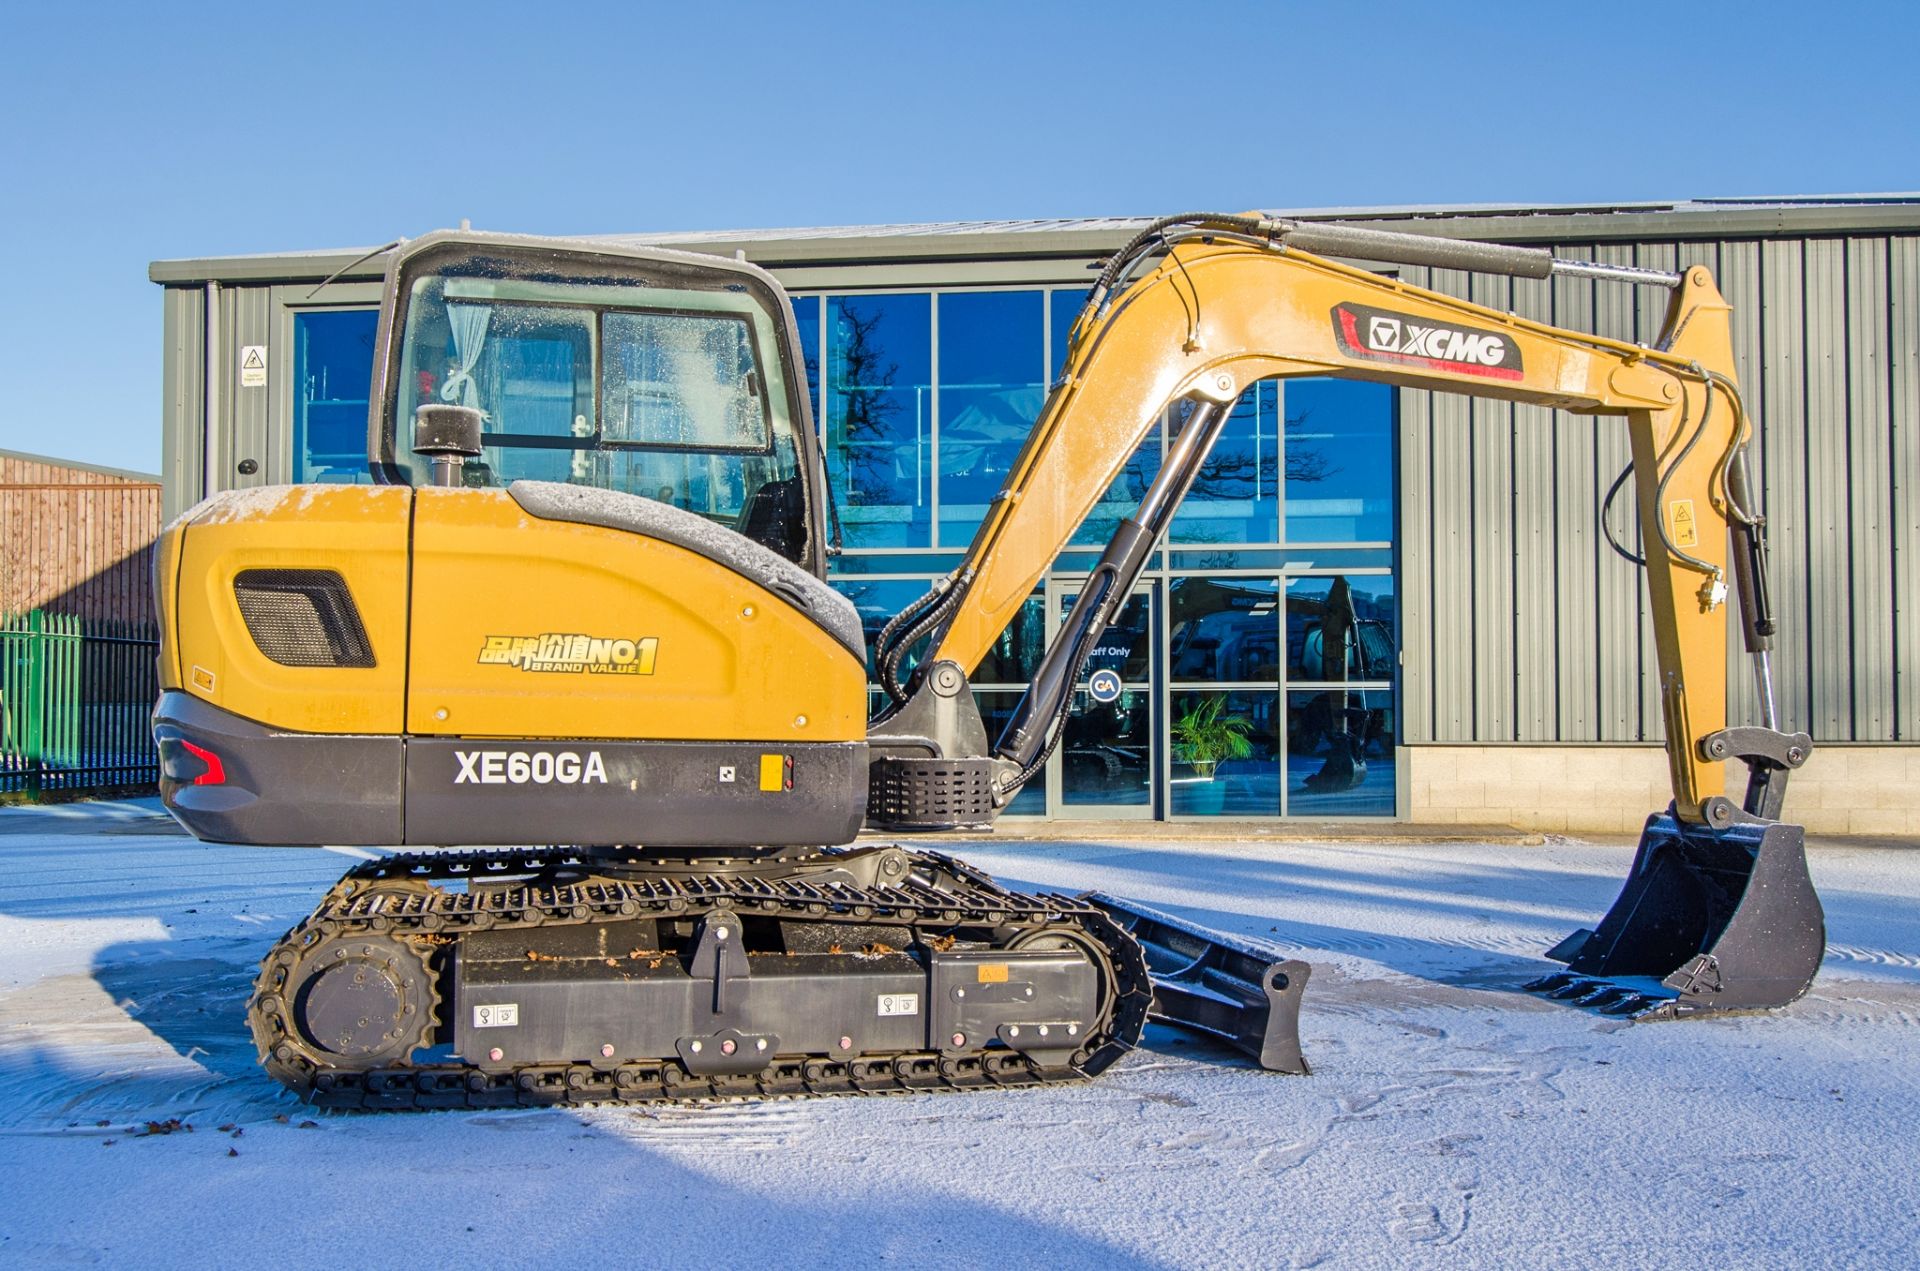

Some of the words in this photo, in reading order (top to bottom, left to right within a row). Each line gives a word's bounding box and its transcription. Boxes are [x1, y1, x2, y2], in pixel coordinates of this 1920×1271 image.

[1399, 325, 1505, 366] XCMG
[1089, 646, 1107, 656] aff
[1108, 646, 1131, 658] Only
[531, 662, 583, 673] BRAND
[590, 663, 638, 674] VALUE
[454, 751, 608, 784] XE60GA
